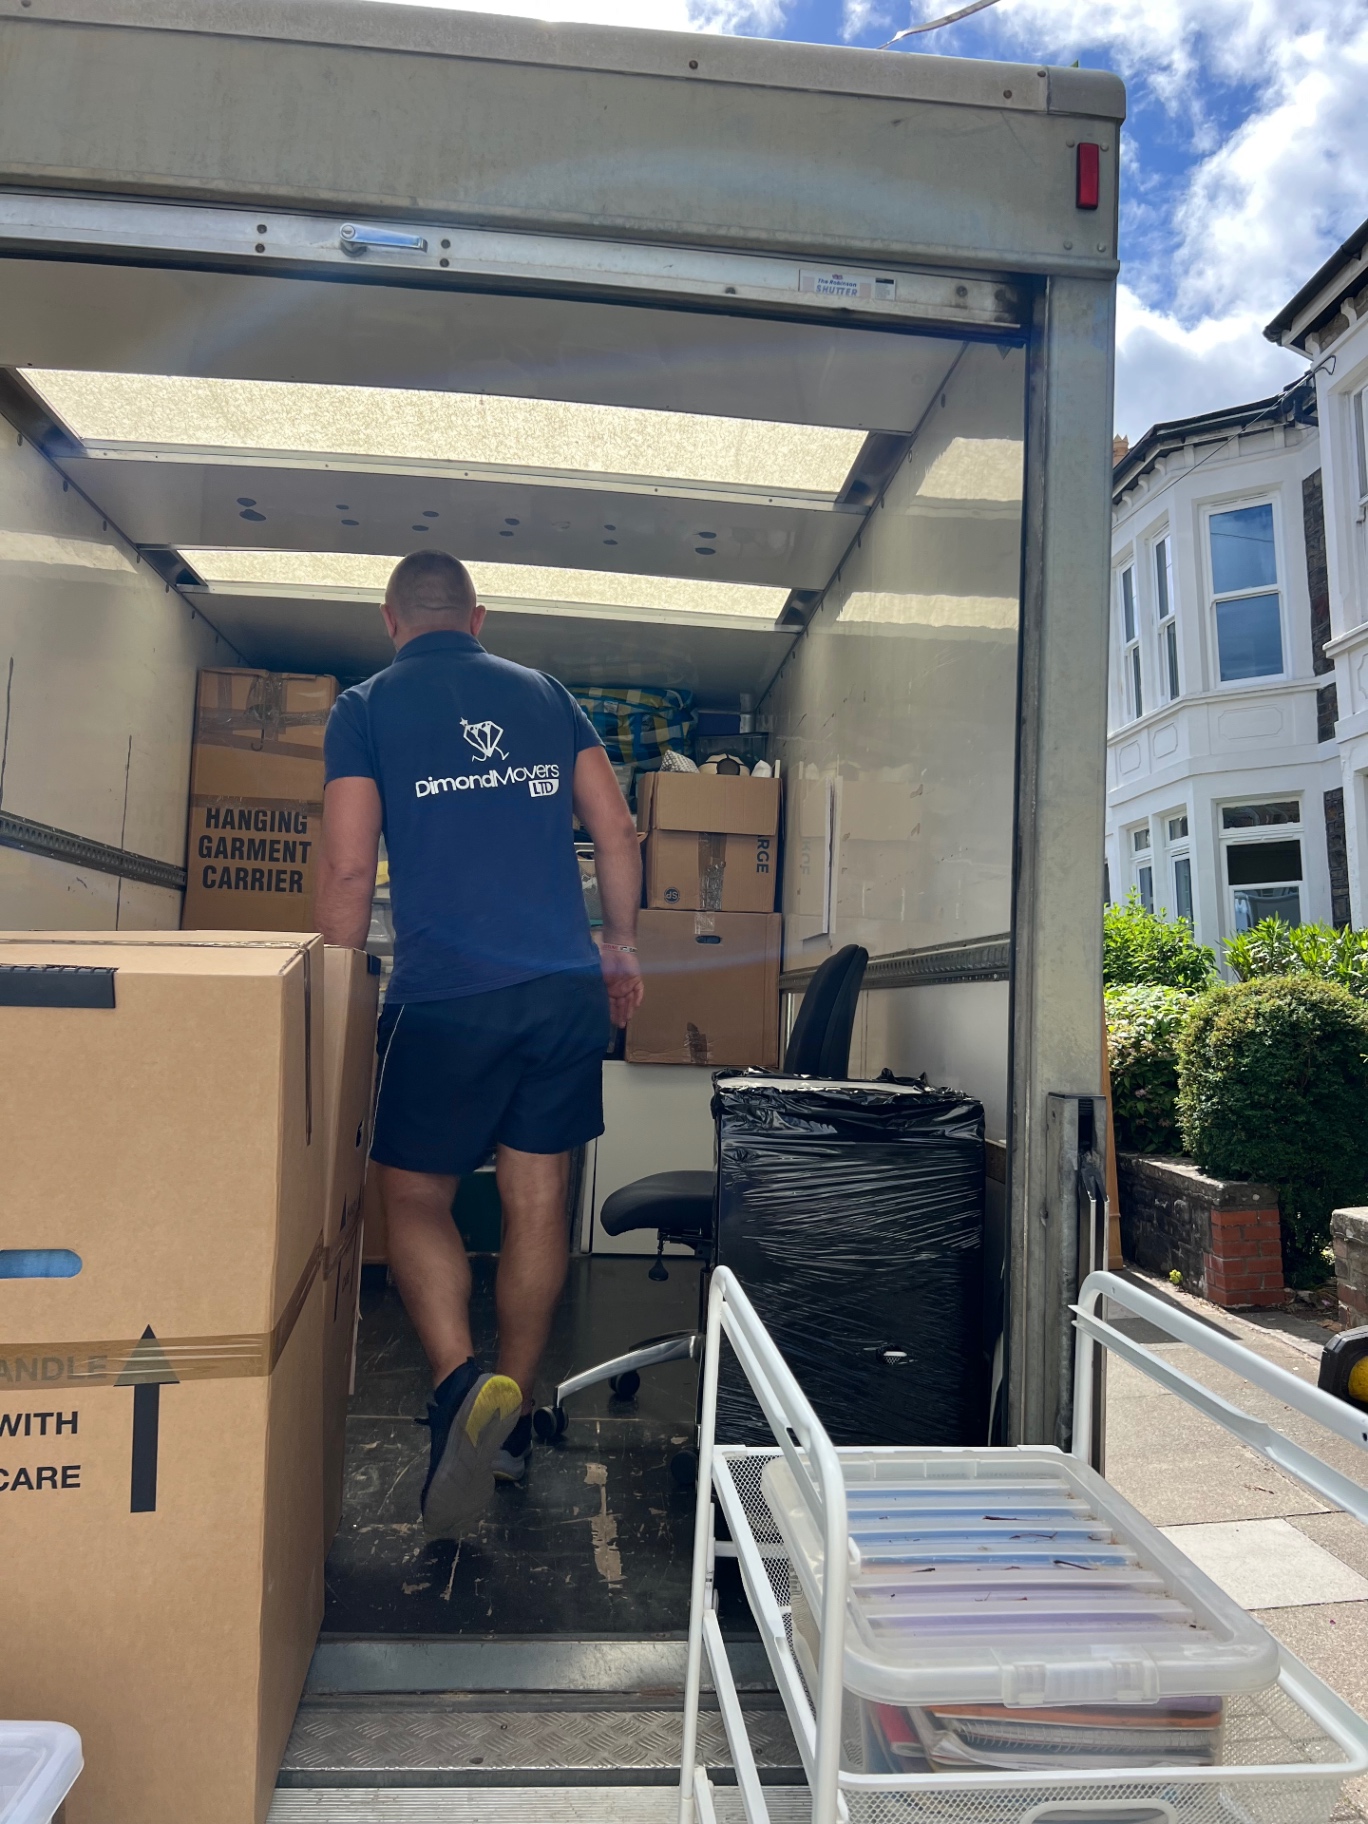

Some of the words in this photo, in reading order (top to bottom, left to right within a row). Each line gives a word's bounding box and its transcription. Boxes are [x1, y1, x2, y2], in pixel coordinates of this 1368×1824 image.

[816, 285, 858, 297] SHUTTER
[415, 764, 559, 798] DimondMovers
[532, 781, 555, 796] LTD
[205, 807, 308, 834] HANGING
[198, 835, 312, 864] GARMENT
[756, 835, 770, 874] RGE
[202, 865, 304, 893] CARRIER
[0, 1354, 108, 1382] ANDLE
[0, 1411, 79, 1437] WITH
